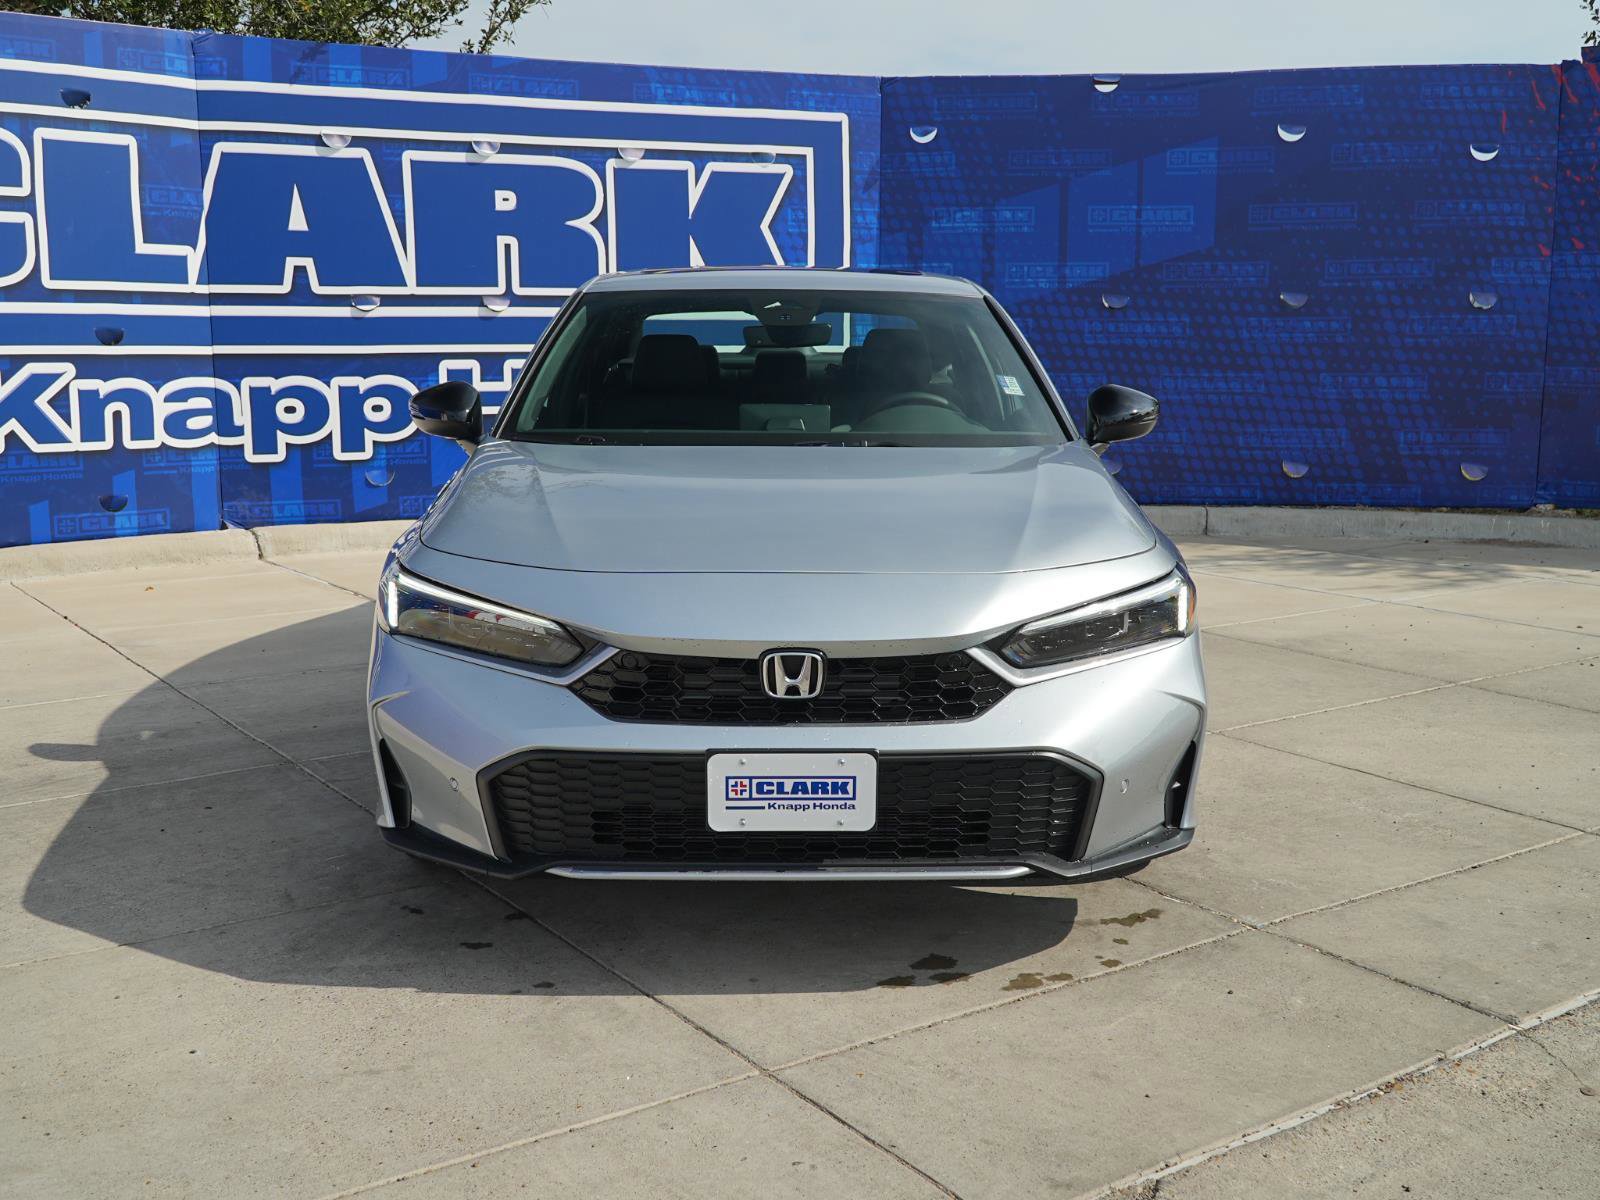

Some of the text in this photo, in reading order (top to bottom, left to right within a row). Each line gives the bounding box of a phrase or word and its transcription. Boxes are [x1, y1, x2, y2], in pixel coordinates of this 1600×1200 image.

[0, 126, 794, 295] LARK
[755, 781, 850, 796] CLARK
[767, 802, 856, 812] Knapp Honda
